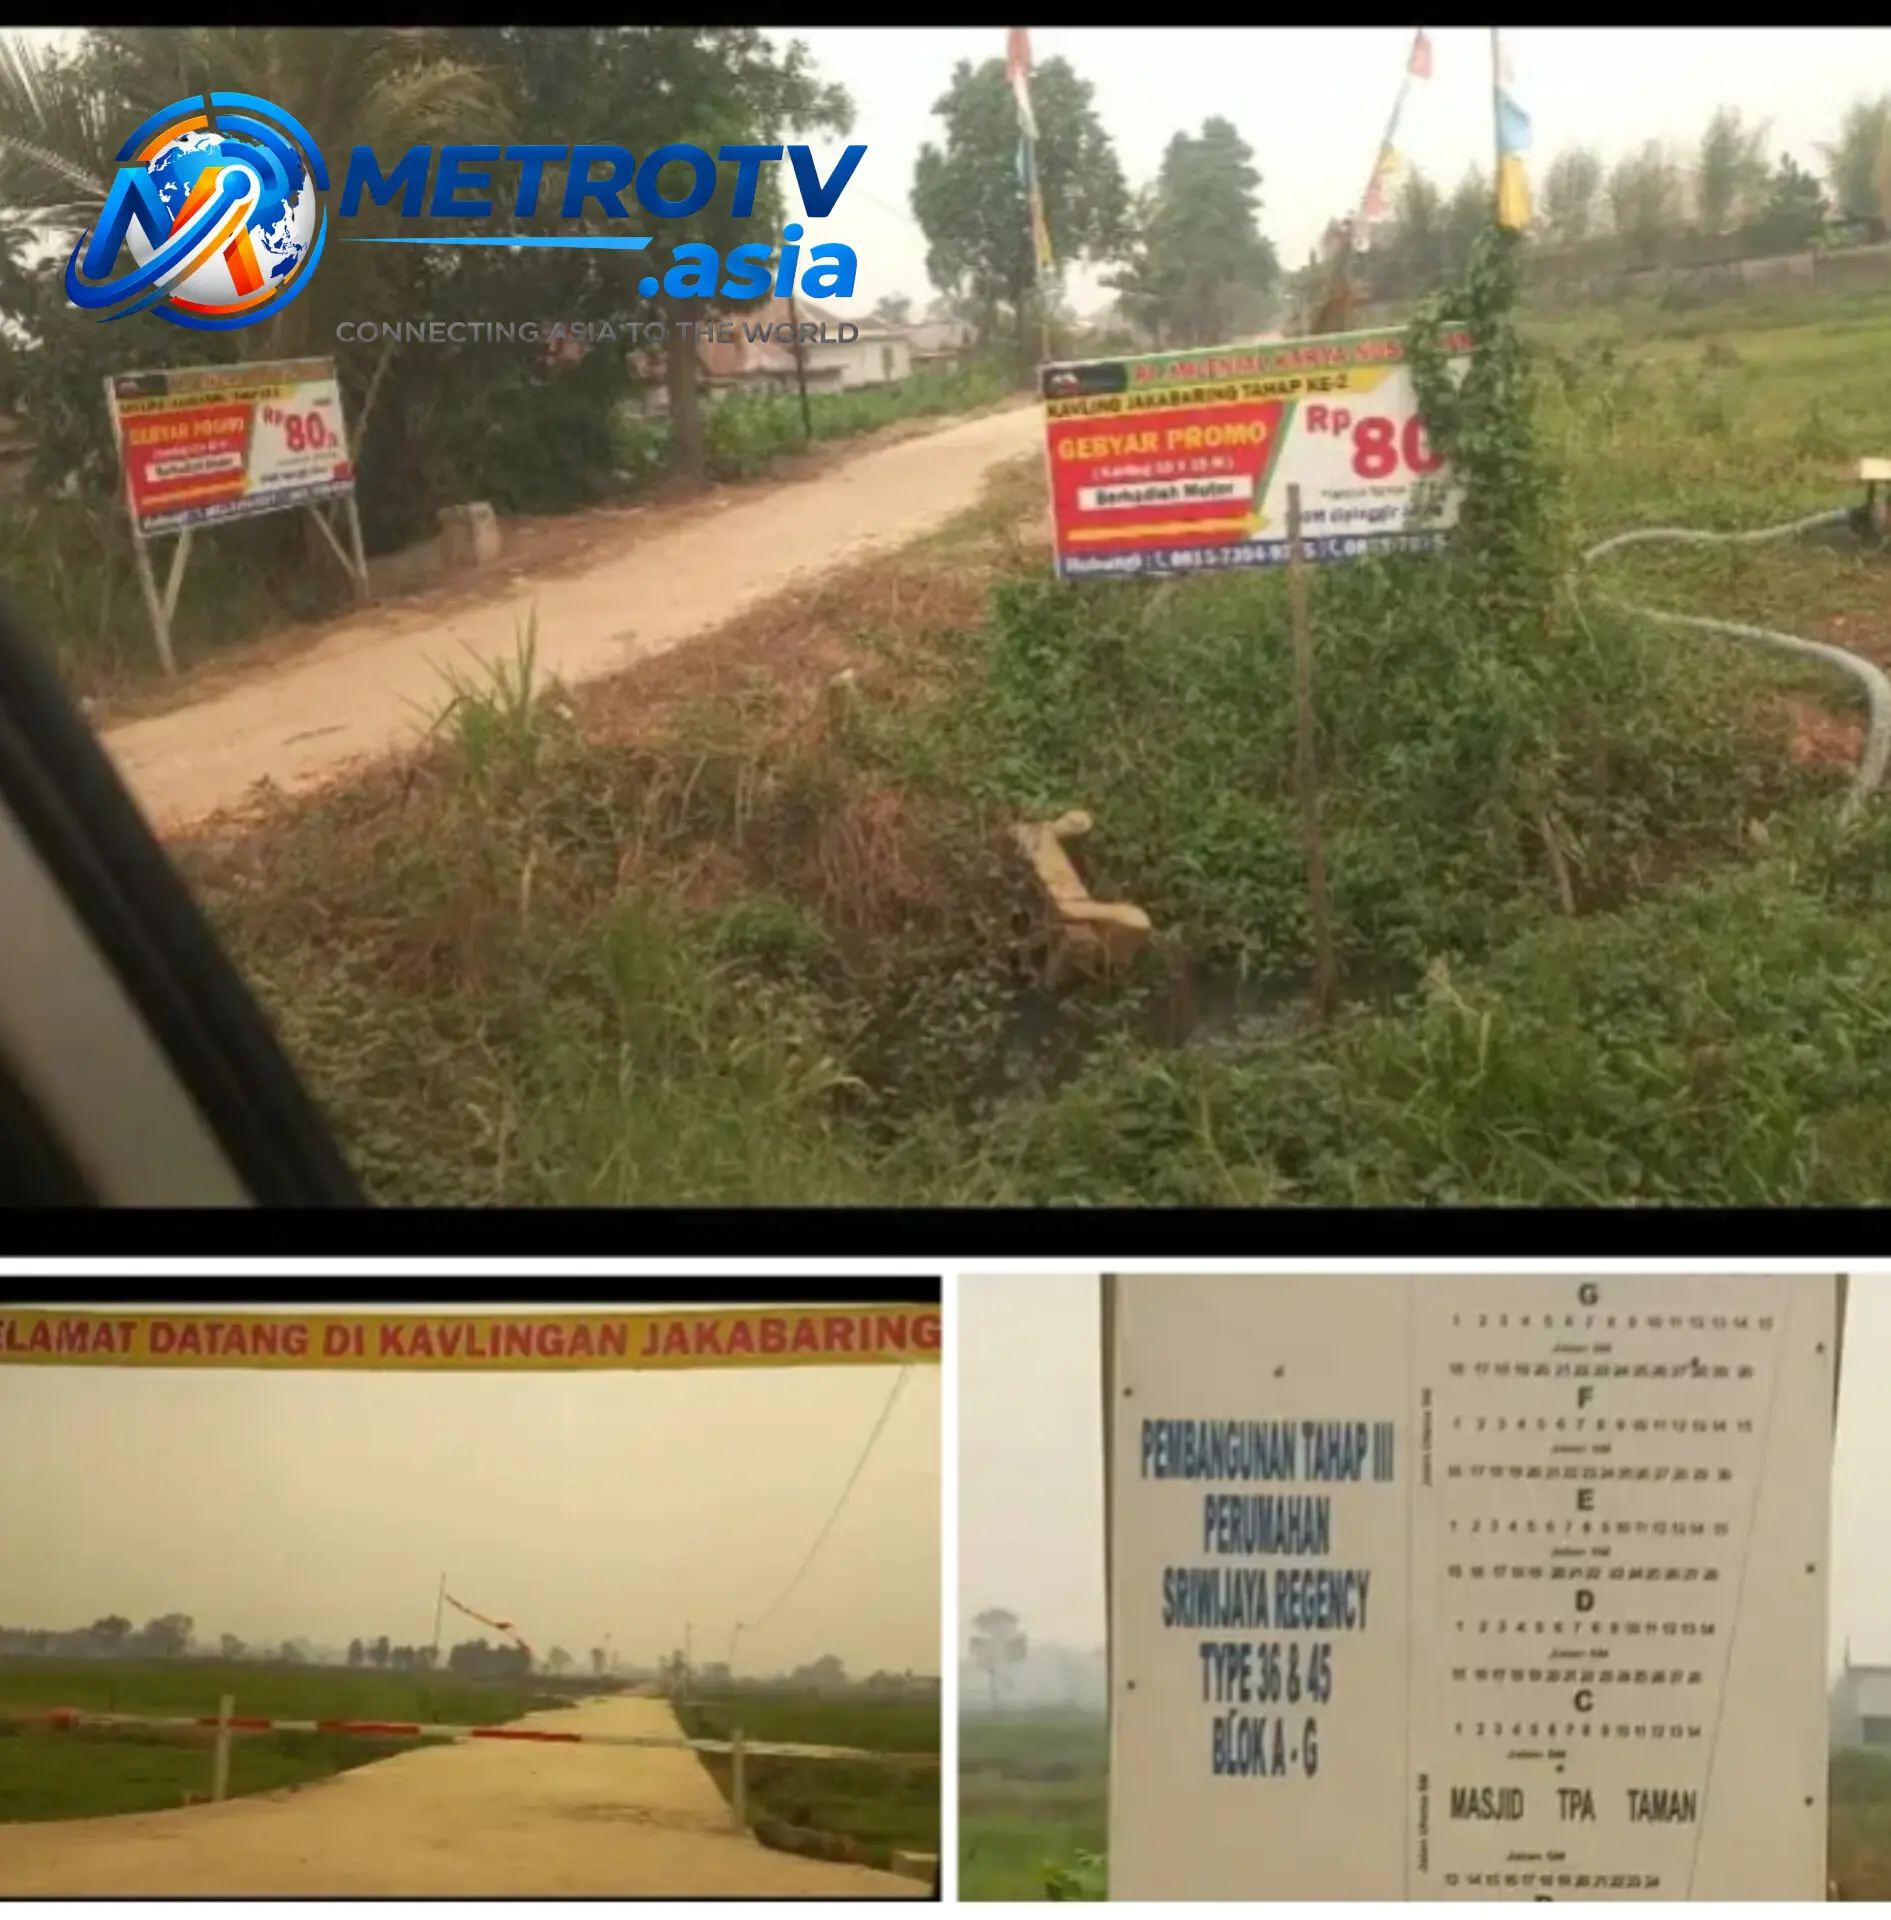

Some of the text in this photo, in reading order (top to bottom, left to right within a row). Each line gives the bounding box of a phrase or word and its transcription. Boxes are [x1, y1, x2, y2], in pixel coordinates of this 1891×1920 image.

[1048, 396, 1122, 416] KAVLING
[1128, 385, 1238, 409] JAKABARING
[1307, 375, 1348, 392] KE-2
[286, 410, 327, 452] 80
[1057, 420, 1267, 461] GEBYAR PROMO
[1306, 404, 1351, 436] Rp
[1577, 1282, 1599, 1306] G
[149, 1321, 309, 1357] DATANG
[323, 1323, 365, 1357] DI
[379, 1322, 628, 1358] KAVLINGAN
[640, 1314, 941, 1357] JAKABARING
[1577, 1385, 1594, 1409] F
[1141, 1419, 1297, 1481] PEMBANGUNAN
[1301, 1421, 1368, 1481] TAHAP
[1372, 1421, 1394, 1482] III
[1576, 1488, 1595, 1511] E
[1204, 1494, 1330, 1555] PERUMAHAN
[1162, 1566, 1371, 1631] SRIWIJAYA REGENCY
[1575, 1589, 1595, 1612] D
[1200, 1642, 1252, 1703] TYPE
[1257, 1642, 1281, 1704] 36
[1307, 1642, 1331, 1704] 45
[1573, 1689, 1594, 1713] C
[1213, 1715, 1267, 1777] BLOK
[1271, 1717, 1286, 1777] A
[1303, 1715, 1318, 1778] G
[1450, 1786, 1697, 1823] MASJID TPA TAMAN
